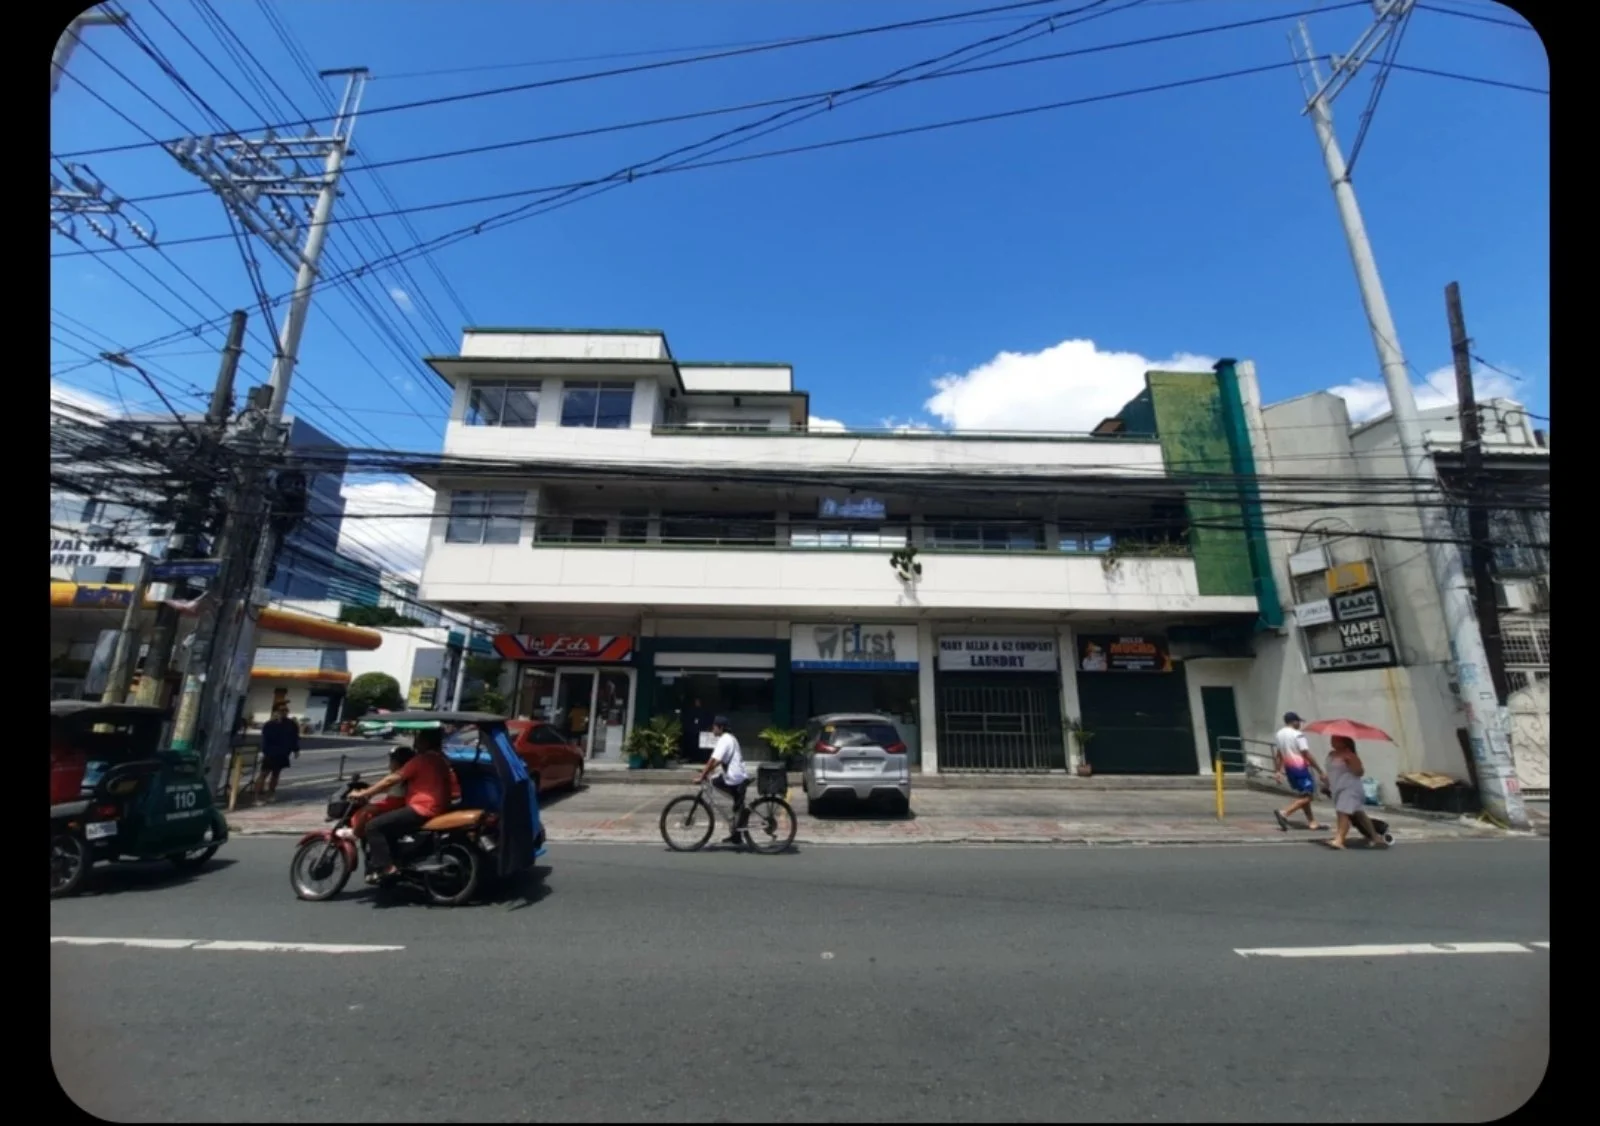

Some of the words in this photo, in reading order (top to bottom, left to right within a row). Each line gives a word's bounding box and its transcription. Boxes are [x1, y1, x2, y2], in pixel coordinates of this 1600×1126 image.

[1340, 621, 1380, 636] VAPE
[1344, 633, 1380, 647] SHOP
[970, 655, 1025, 667] LAUNDRY
[174, 791, 196, 809] 110
